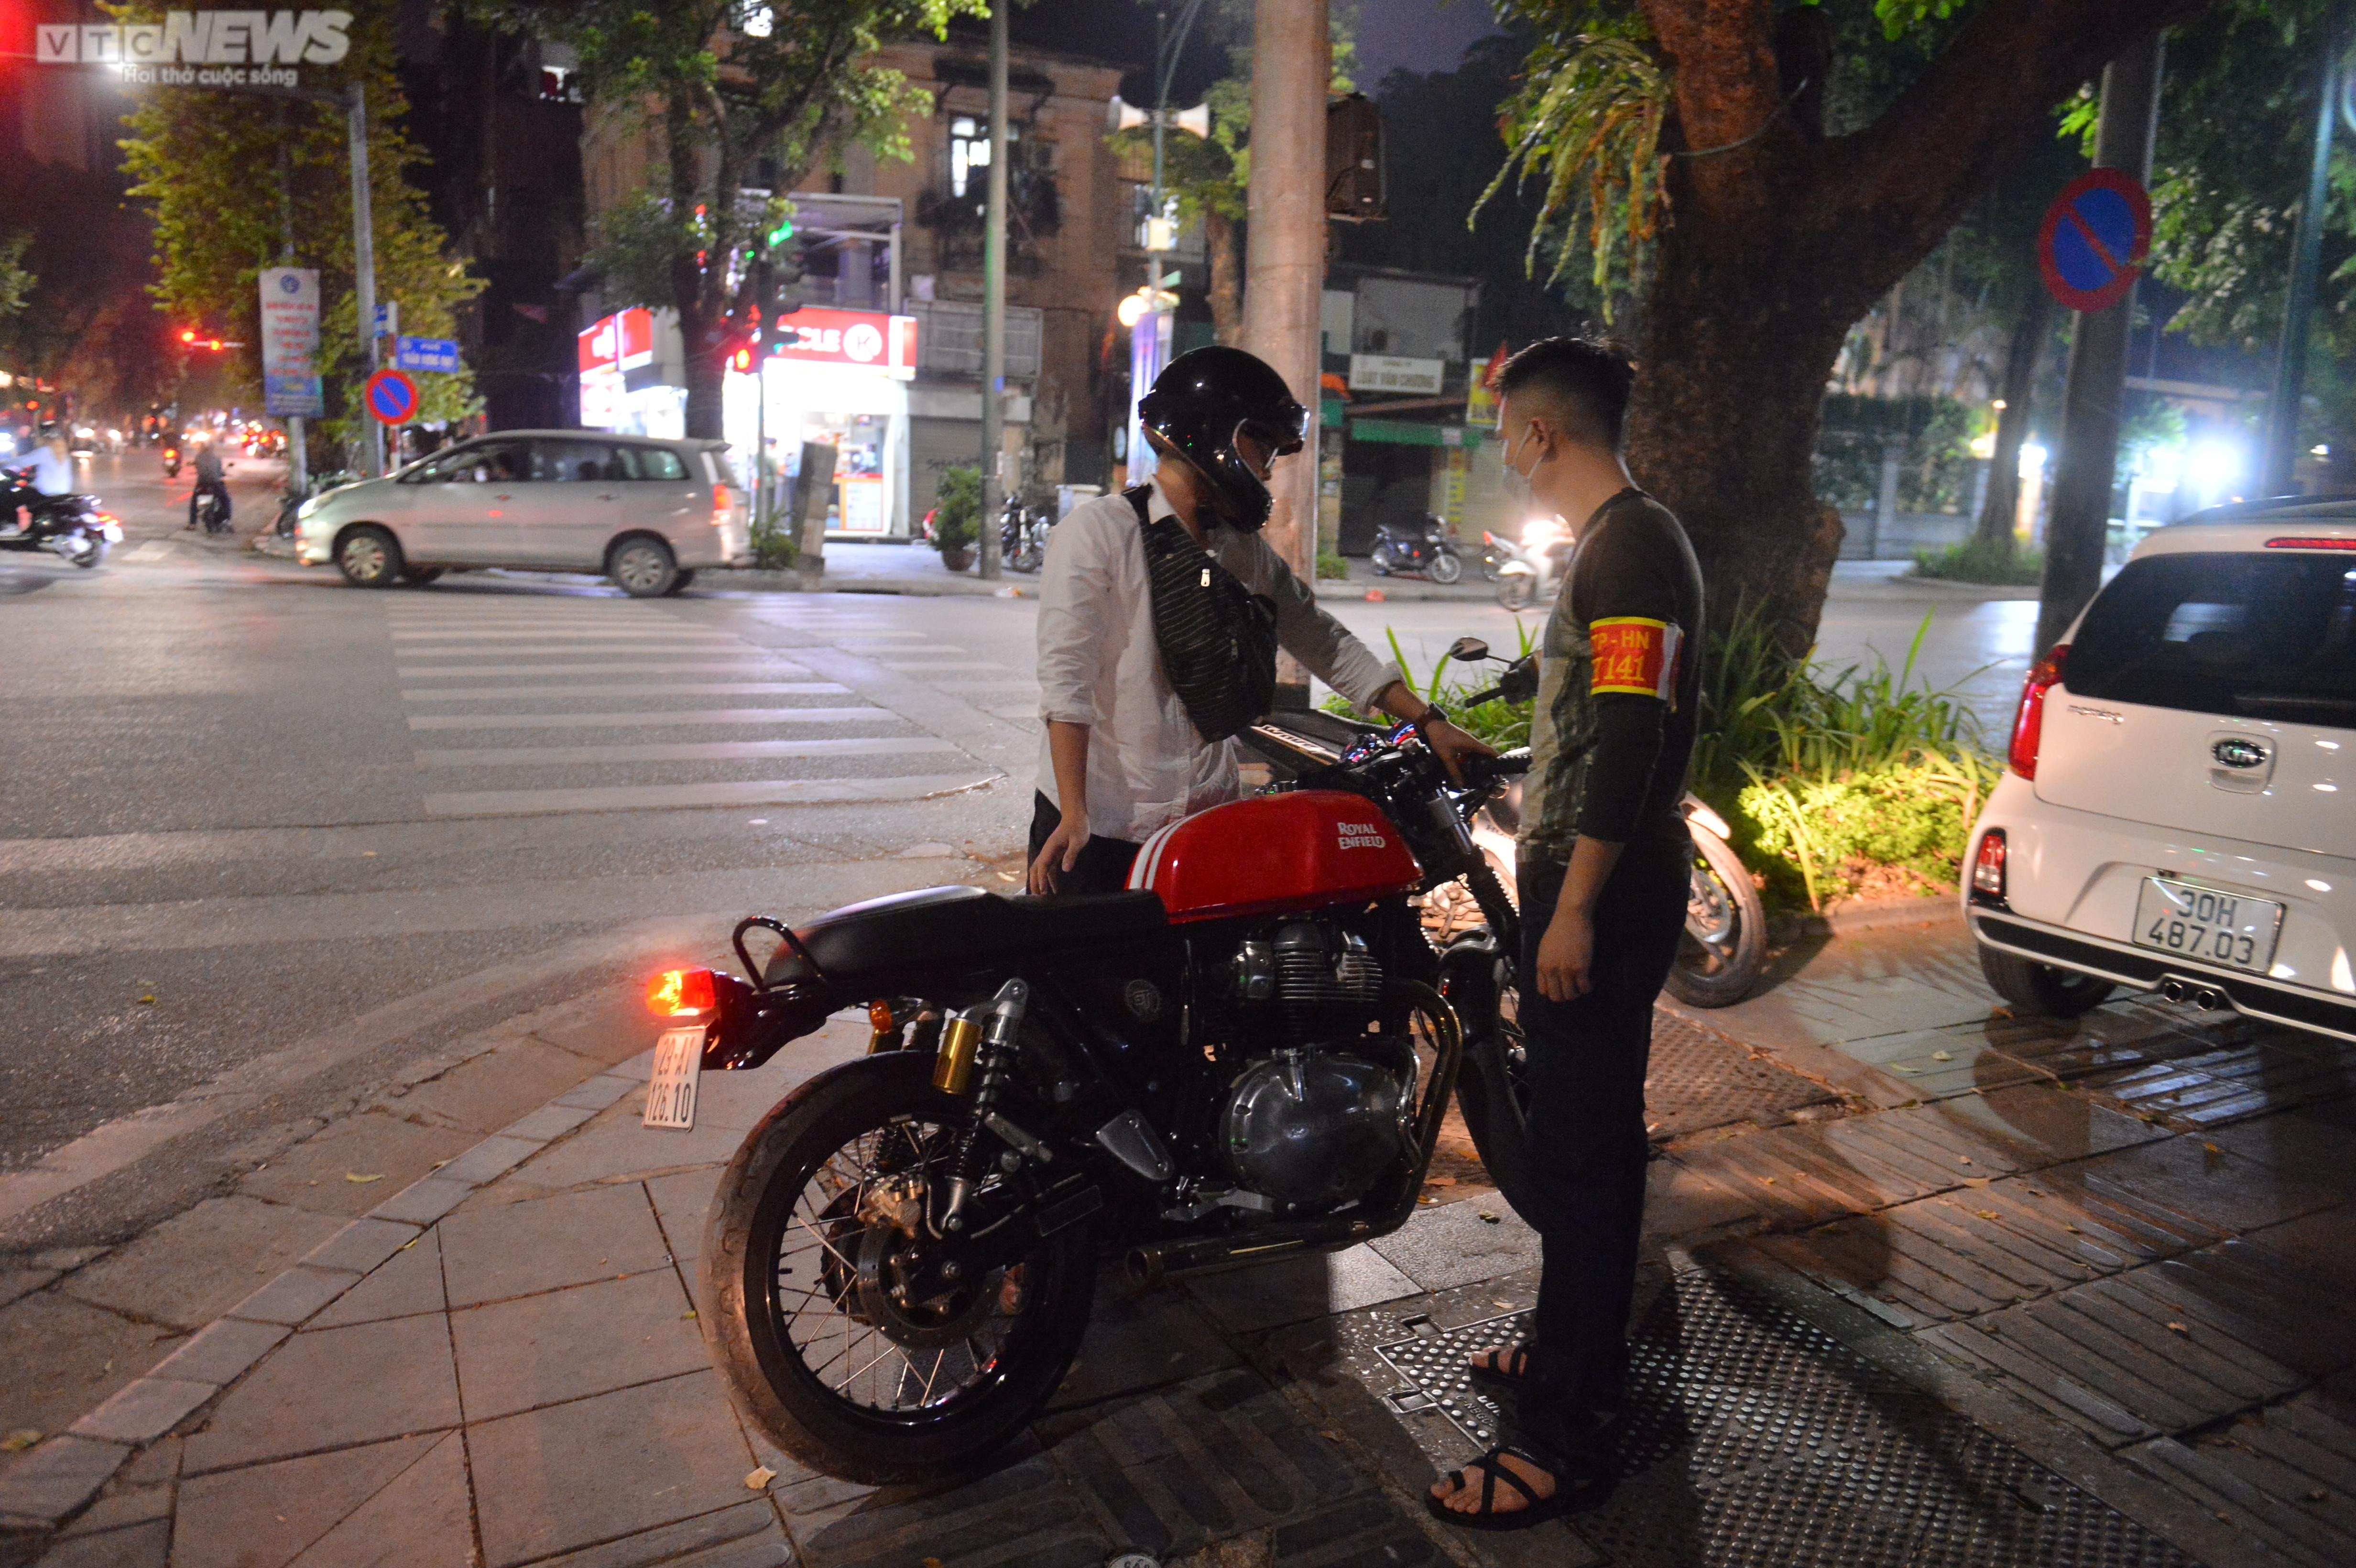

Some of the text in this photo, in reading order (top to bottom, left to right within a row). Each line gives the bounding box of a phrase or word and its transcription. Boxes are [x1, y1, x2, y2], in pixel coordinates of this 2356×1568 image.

[1337, 822, 1377, 835] ROYAL
[1338, 836, 1386, 849] ENFIELD
[2177, 890, 2237, 927] 30H
[2149, 917, 2255, 965] 487.03
